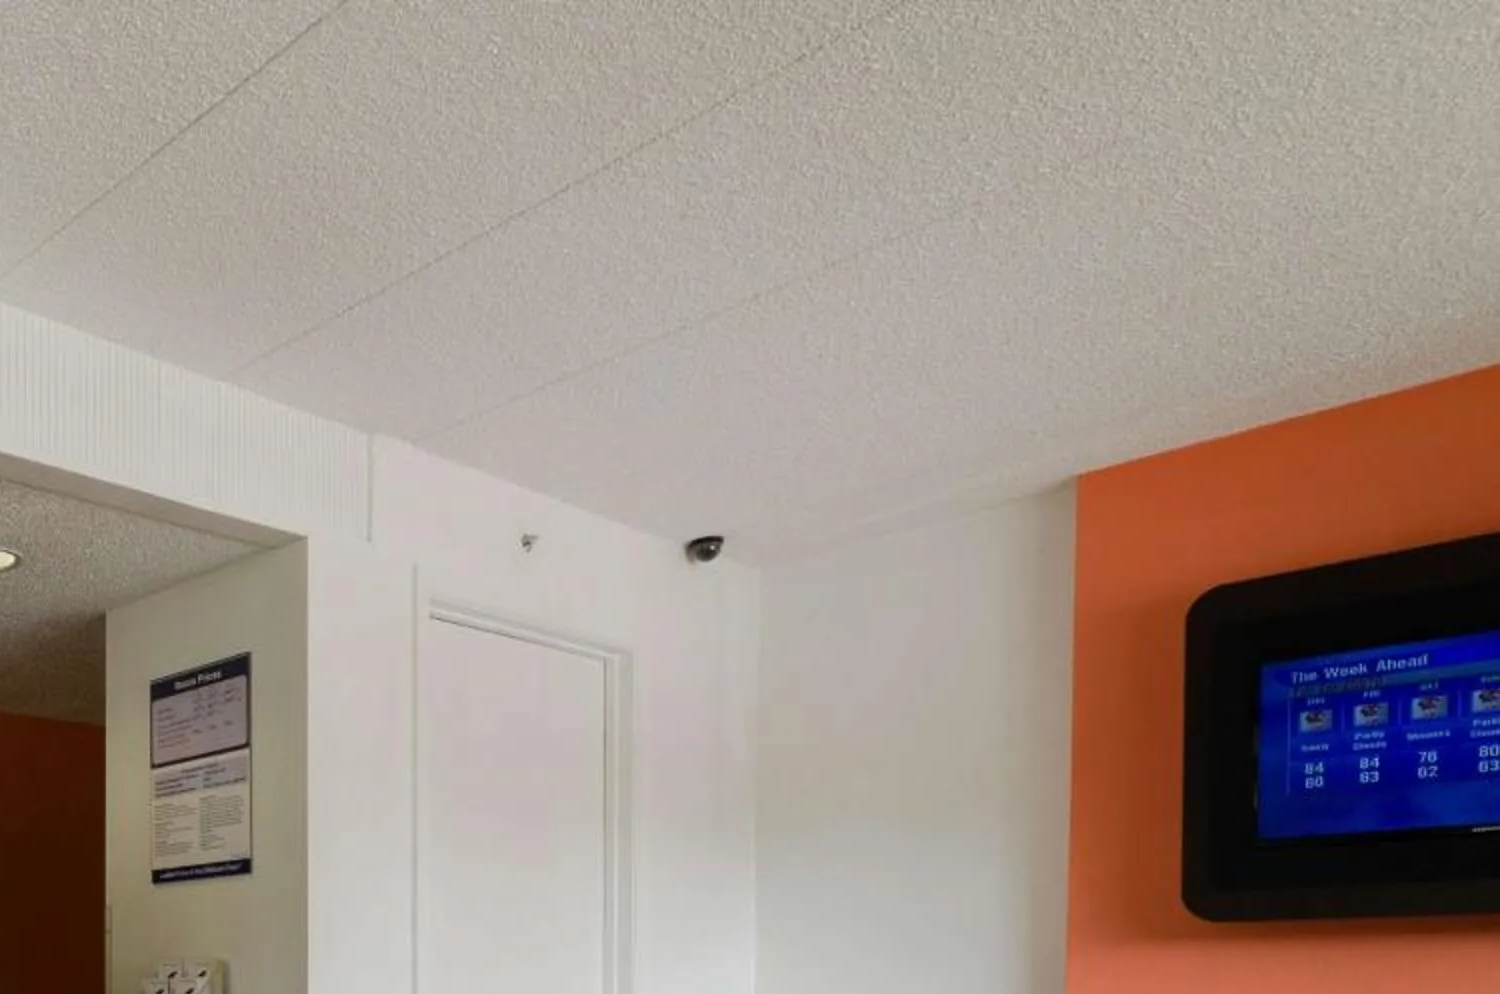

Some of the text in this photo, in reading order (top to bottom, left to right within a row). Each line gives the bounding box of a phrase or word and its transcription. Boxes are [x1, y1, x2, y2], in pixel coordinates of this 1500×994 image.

[1291, 653, 1429, 685] The Week Ahead
